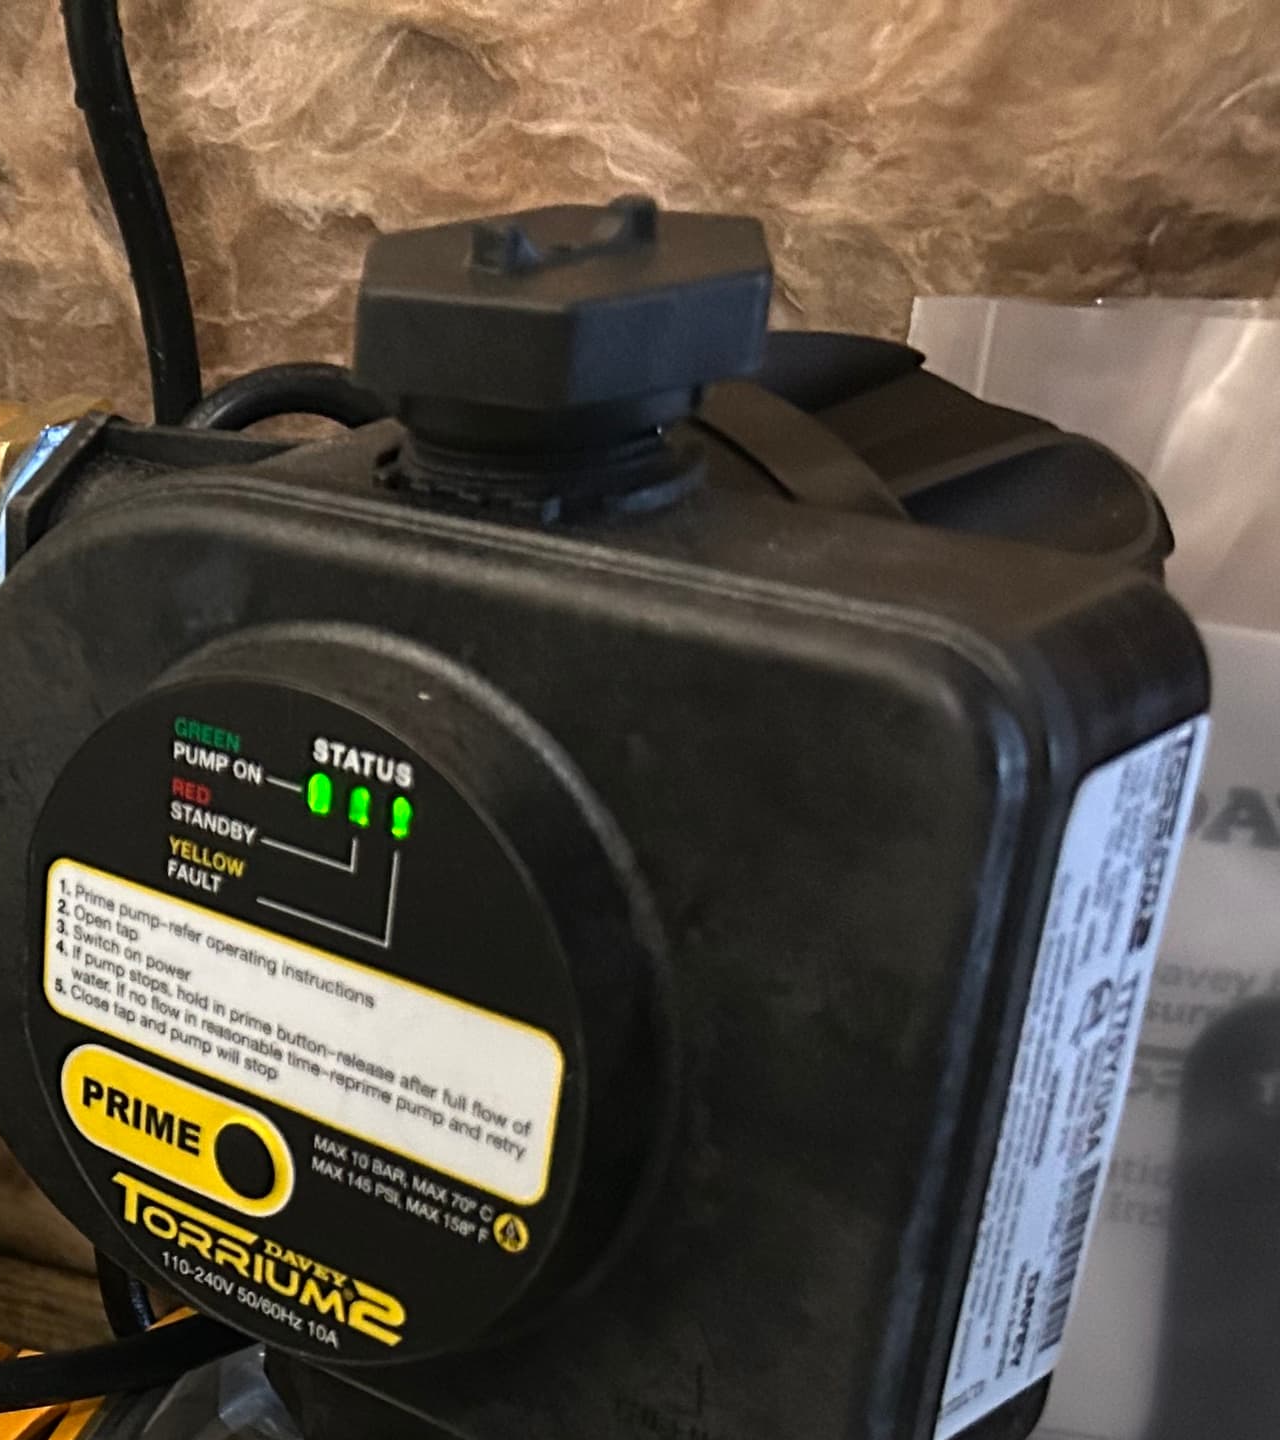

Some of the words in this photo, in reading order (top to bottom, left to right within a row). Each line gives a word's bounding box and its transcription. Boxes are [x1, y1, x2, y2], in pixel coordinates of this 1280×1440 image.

[174, 716, 241, 751] GREEN
[173, 741, 229, 772] PUMP
[233, 760, 263, 784] ON
[313, 738, 413, 788] STATUS
[172, 777, 211, 805] RED
[170, 801, 256, 846] STANDBY
[167, 859, 222, 893] FAULT
[169, 835, 245, 877] YELLOW
[58, 899, 69, 916] 2.
[74, 905, 112, 933] Open
[117, 923, 139, 942] tap
[59, 880, 72, 896] 1.
[75, 883, 114, 912] Prime
[206, 936, 277, 975] operating
[281, 960, 376, 1009] instructions
[56, 919, 68, 935] 3.
[74, 925, 120, 954] Switch
[124, 949, 141, 962] on
[146, 956, 192, 982] power
[55, 978, 67, 995] 5.
[71, 985, 109, 1012] Close
[114, 1002, 135, 1022] tap
[140, 1015, 166, 1035] and
[170, 1028, 212, 1054] pump
[216, 1044, 240, 1064] will
[244, 1057, 278, 1081] stop
[56, 940, 68, 957] 4.
[73, 945, 82, 959] If
[85, 953, 125, 978] pump
[177, 988, 208, 1010] hold
[213, 1001, 225, 1017] in
[230, 1008, 272, 1035] prime
[400, 1075, 437, 1099] after
[442, 1088, 466, 1112] full
[472, 1101, 508, 1127] flow
[513, 1119, 532, 1137] of
[130, 991, 146, 1006] no
[151, 996, 180, 1019] flow
[185, 1010, 197, 1025] in
[202, 1019, 283, 1061] reasonable
[396, 1096, 444, 1127] pump
[449, 1117, 481, 1140] and
[486, 1132, 527, 1161] retry
[82, 1076, 202, 1156] PRIME
[312, 1156, 344, 1182] MAX
[347, 1172, 372, 1194] 145
[375, 1183, 402, 1209] PSI,
[406, 1197, 440, 1224] MAX
[478, 1227, 489, 1243] F
[314, 1134, 348, 1161] MAX
[352, 1151, 369, 1169] 10
[372, 1158, 409, 1188] BAR,
[413, 1175, 448, 1203] MAX
[479, 1204, 494, 1222] C
[264, 1240, 348, 1288] DAVEY
[162, 1251, 234, 1296] 110-240V
[238, 1287, 302, 1331] 50/60Hz
[308, 1321, 339, 1349] 10A
